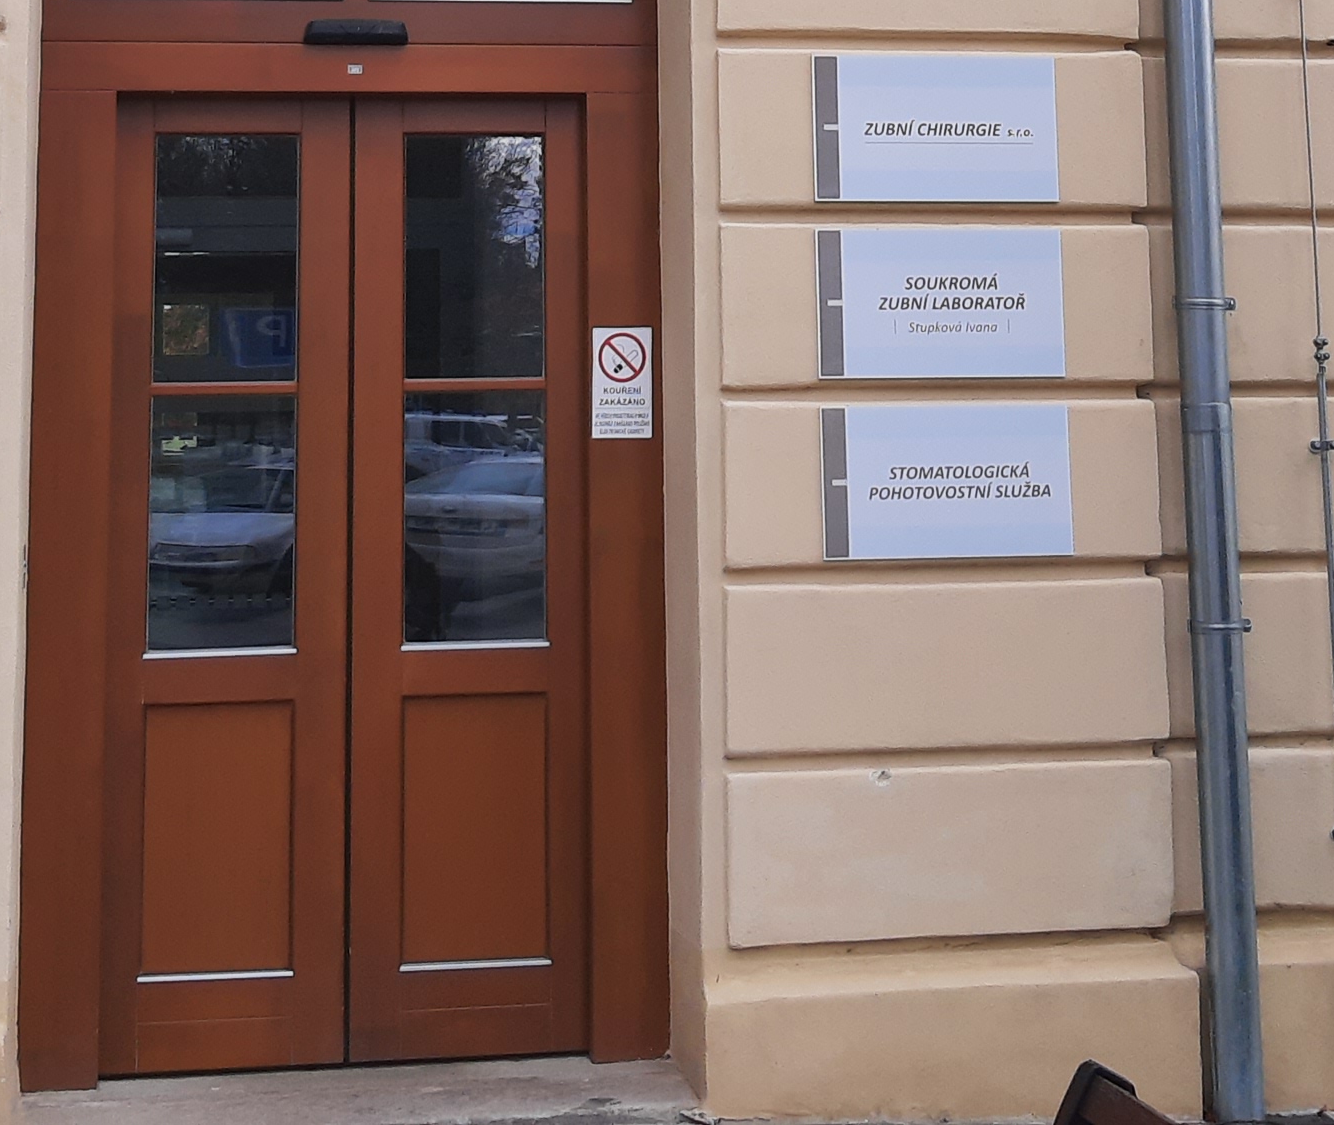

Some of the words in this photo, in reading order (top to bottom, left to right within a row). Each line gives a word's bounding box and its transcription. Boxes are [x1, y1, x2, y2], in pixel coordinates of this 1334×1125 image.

[864, 120, 915, 136] ZUBNÍ
[917, 123, 1002, 137] CHIRURGIE
[904, 273, 998, 291] SOUKROMÁ
[878, 293, 929, 311] ZUBNÍ
[931, 293, 1026, 311] LABORATOŘ
[908, 321, 962, 335] Stupková
[965, 322, 998, 333] Ivana
[603, 385, 642, 395] KOUŘENÍ
[599, 396, 646, 406] ZAKÁZÁNO
[889, 462, 1029, 480] STOMATOLOGICKÁ
[869, 482, 993, 500] POHOTOVOSTNÍ
[994, 481, 1051, 499] SLUŽBA
